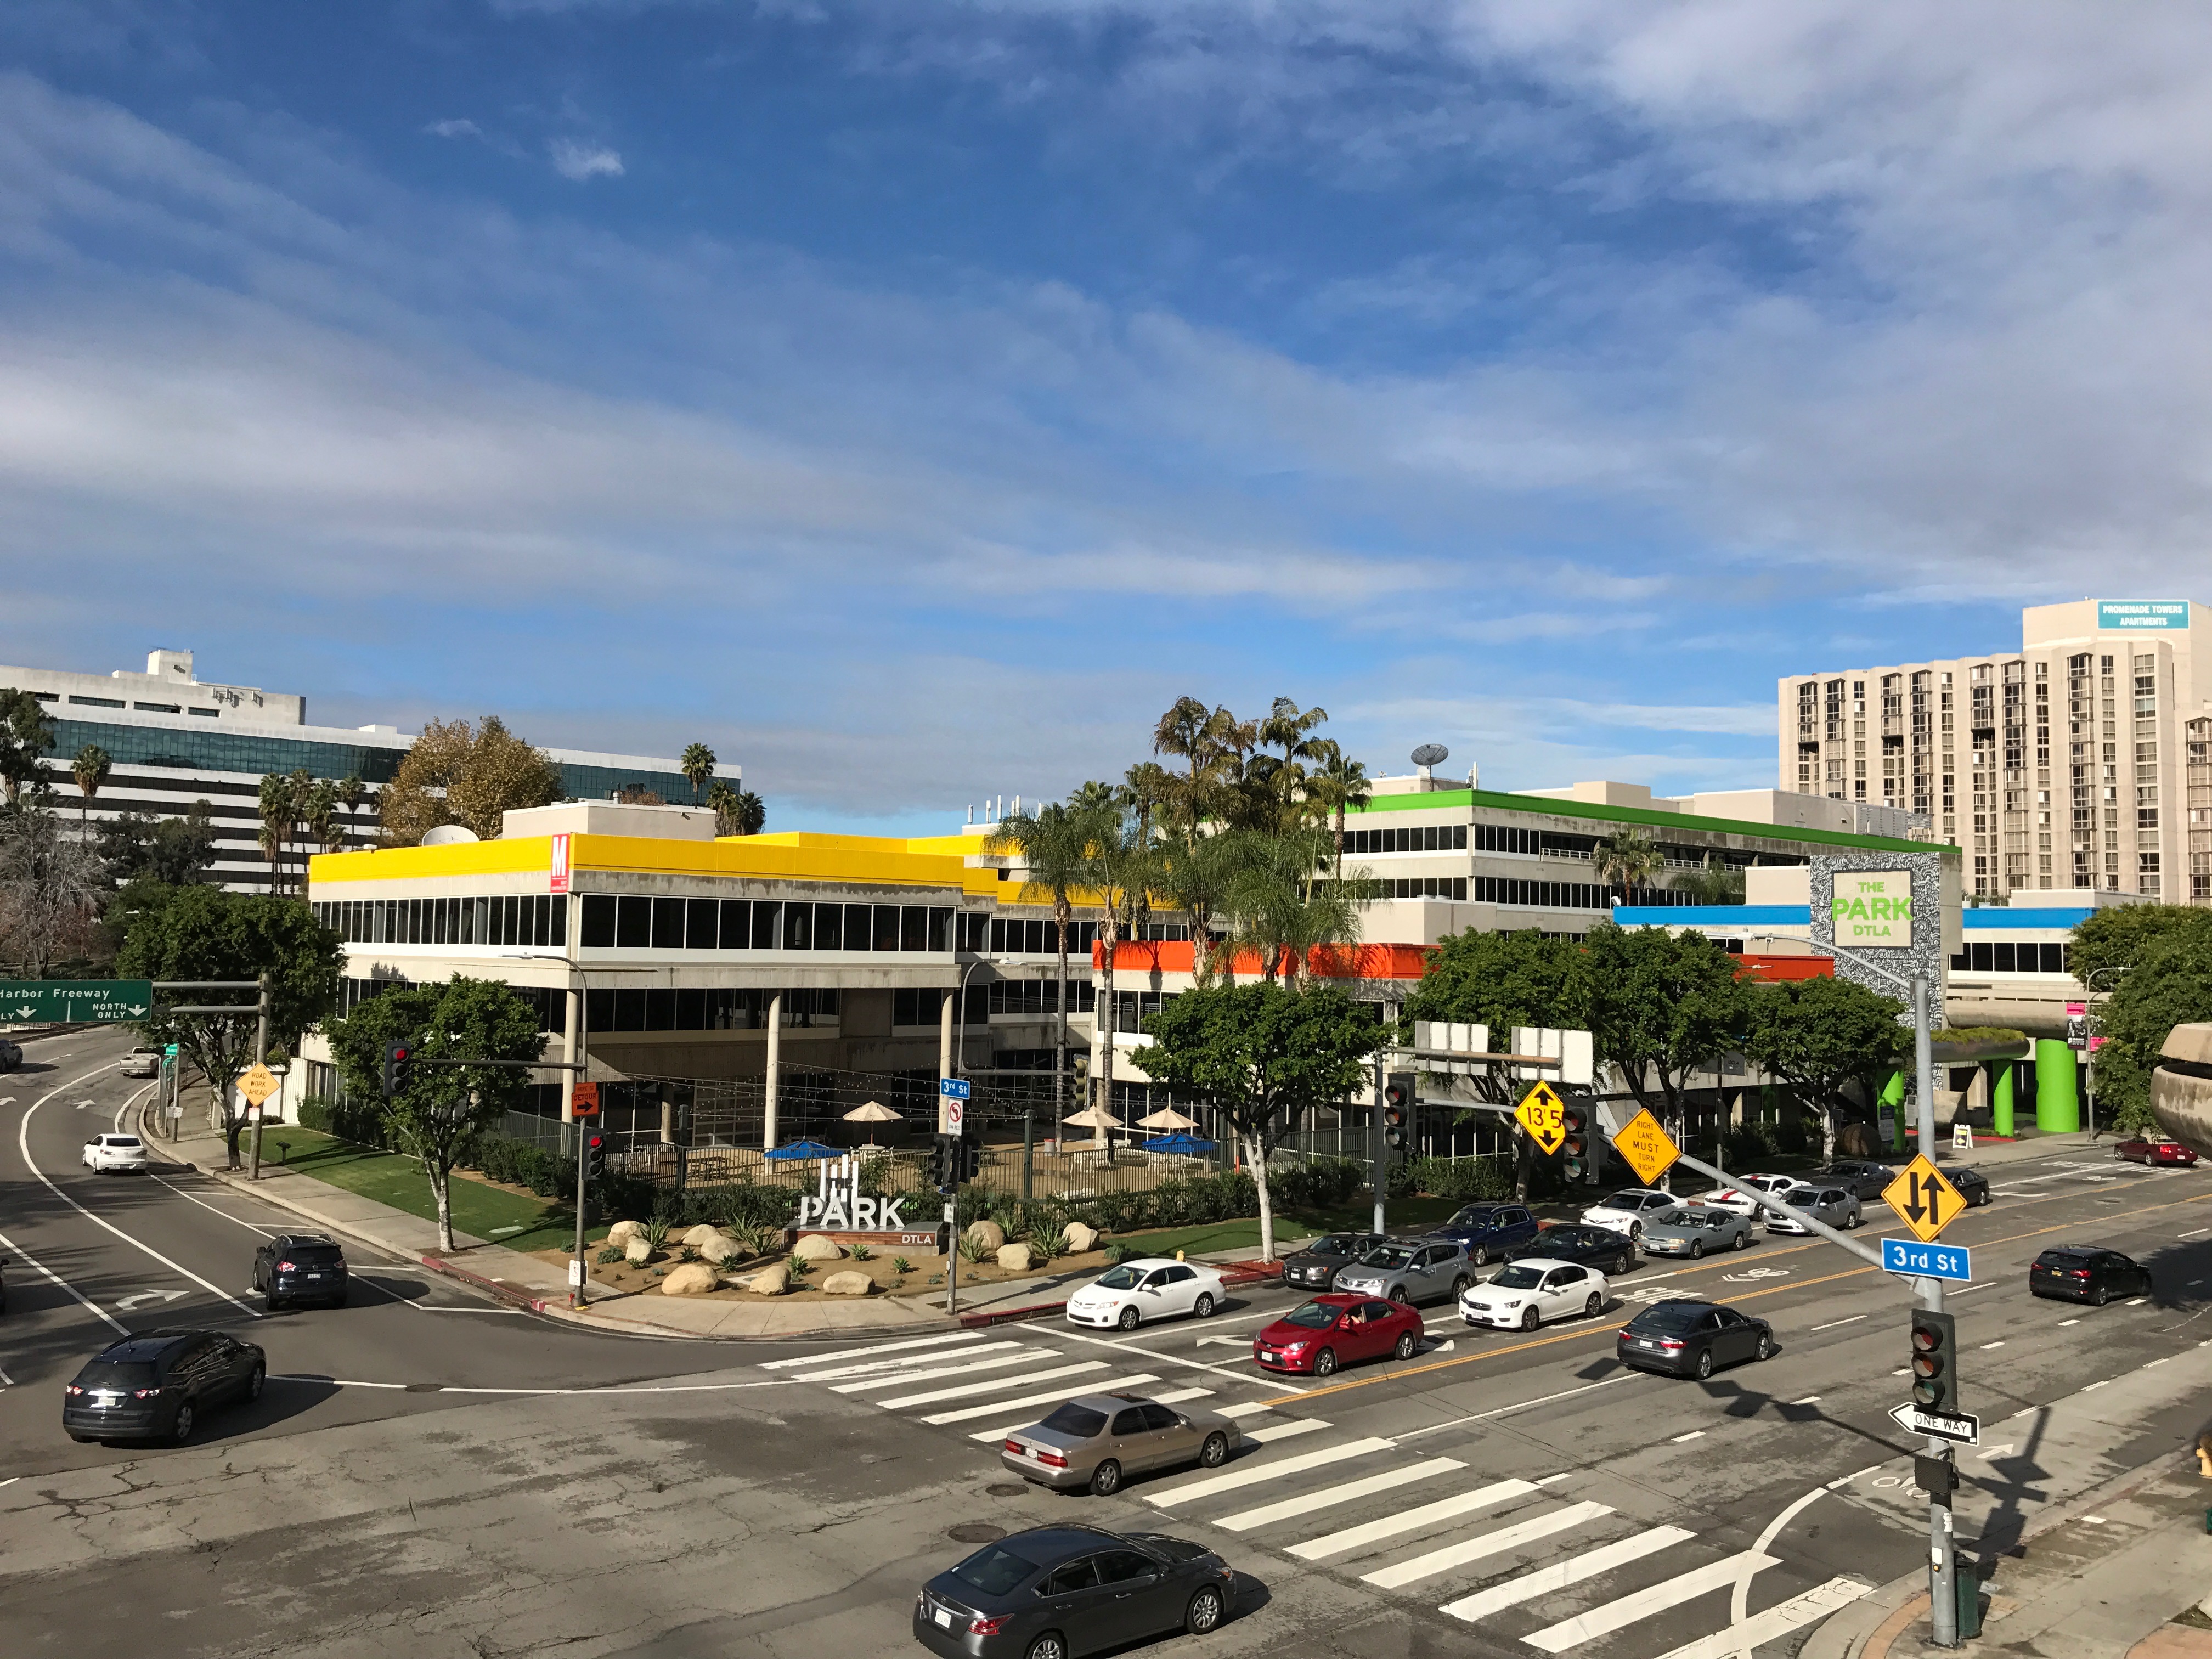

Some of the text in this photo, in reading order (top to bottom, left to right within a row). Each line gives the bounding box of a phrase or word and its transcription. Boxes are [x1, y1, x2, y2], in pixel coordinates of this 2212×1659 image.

[2102, 605, 2183, 614] PROMENADE TOWERS
[2120, 617, 2168, 626] APARTMENTS
[552, 836, 567, 877] M
[1858, 881, 1885, 893] THE
[1831, 896, 1914, 921] PARK
[1853, 924, 1892, 936] DTLA
[53, 989, 110, 1001] Freeway
[944, 1081, 967, 1095] 3rd St
[1637, 1120, 1654, 1130] RIGHT
[1638, 1131, 1654, 1141] LANE
[1633, 1141, 1659, 1153] MUST
[1638, 1153, 1655, 1163] TURN
[1638, 1163, 1655, 1172] RIGHT
[825, 1177, 853, 1189] THE
[800, 1196, 905, 1227] PARK
[902, 1234, 932, 1244] DTLA
[1893, 1246, 1958, 1272] 3rd St
[1915, 1414, 1967, 1434] ONE WAY
